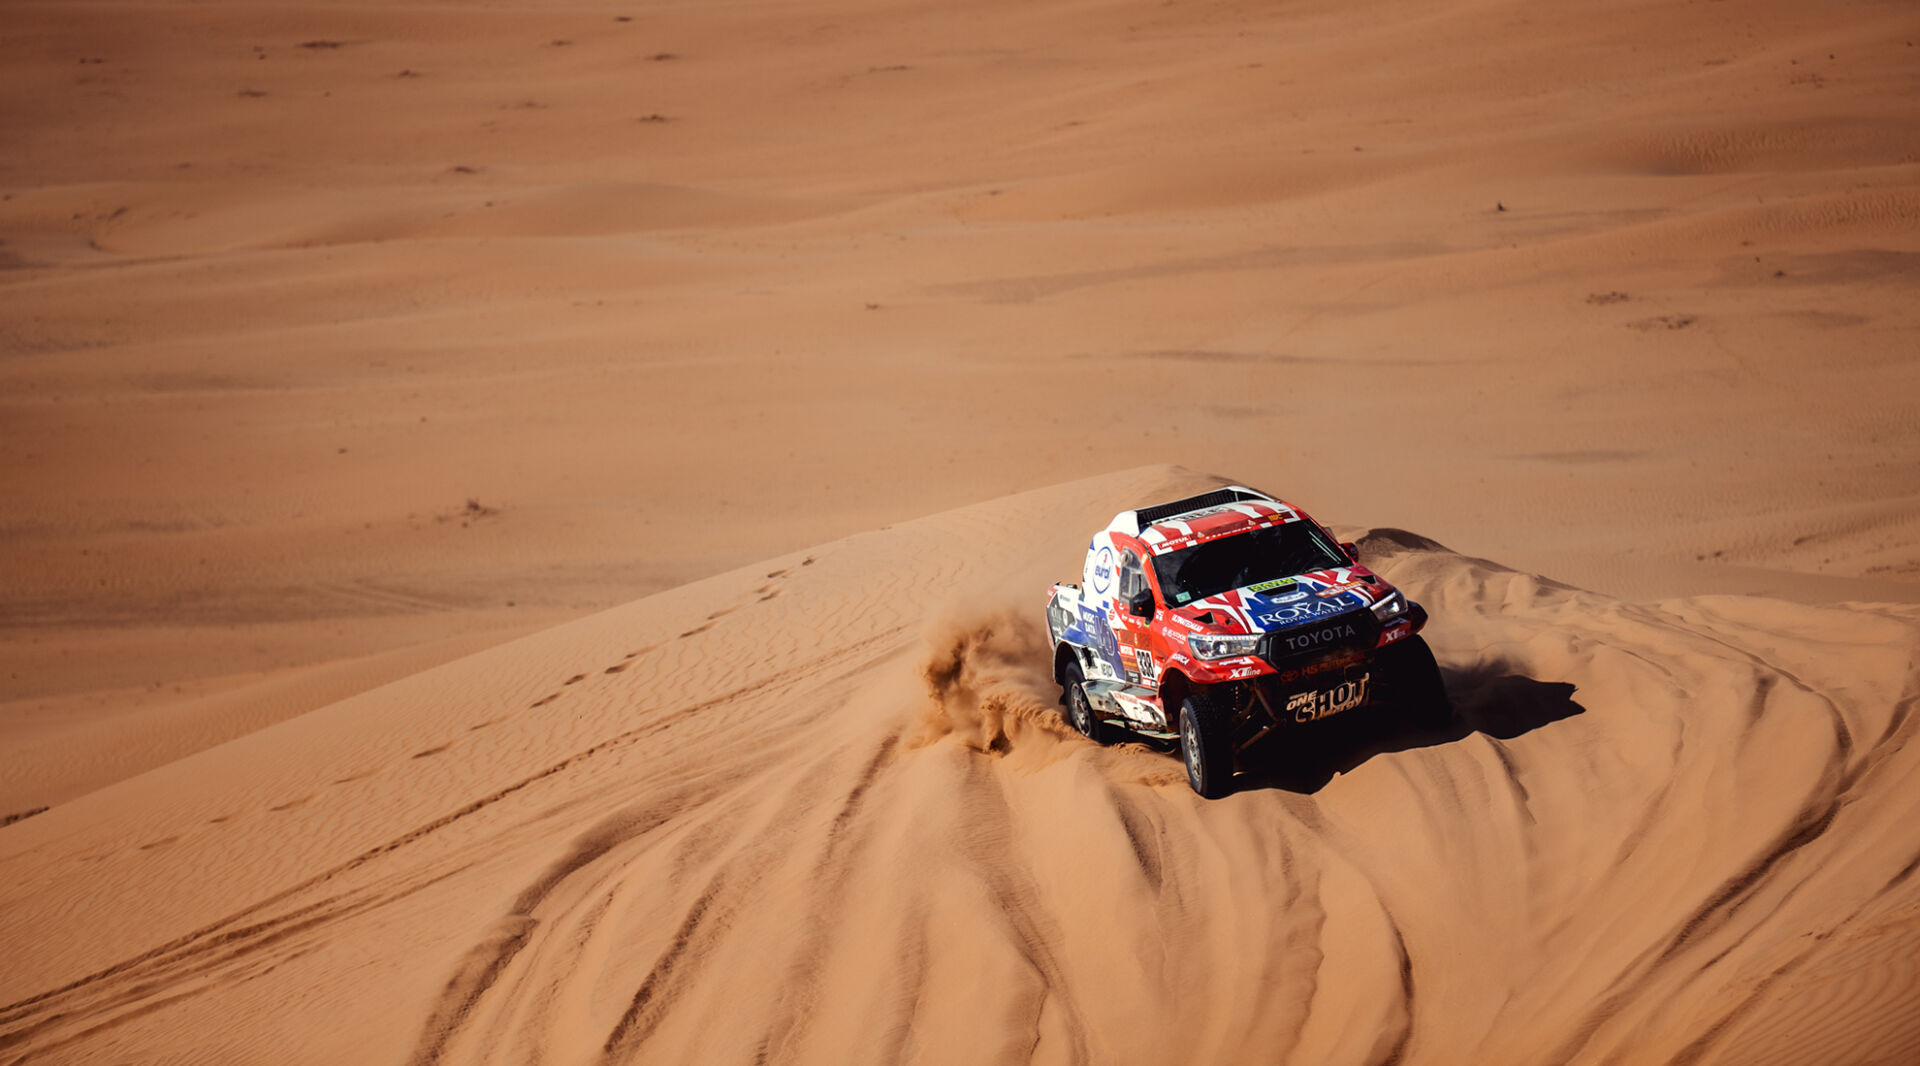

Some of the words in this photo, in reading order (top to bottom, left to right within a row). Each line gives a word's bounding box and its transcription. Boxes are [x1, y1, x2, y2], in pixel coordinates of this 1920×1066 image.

[1161, 536, 1189, 548] MOTUL
[1095, 565, 1110, 579] eurol
[1258, 597, 1355, 626] ROYAL
[1280, 614, 1311, 625] ROYAL
[1312, 607, 1344, 617] WATER
[1286, 624, 1356, 650] TOYOTA
[1136, 650, 1155, 679] 338
[1286, 690, 1318, 711] ONE
[1295, 672, 1370, 723] SHOT
